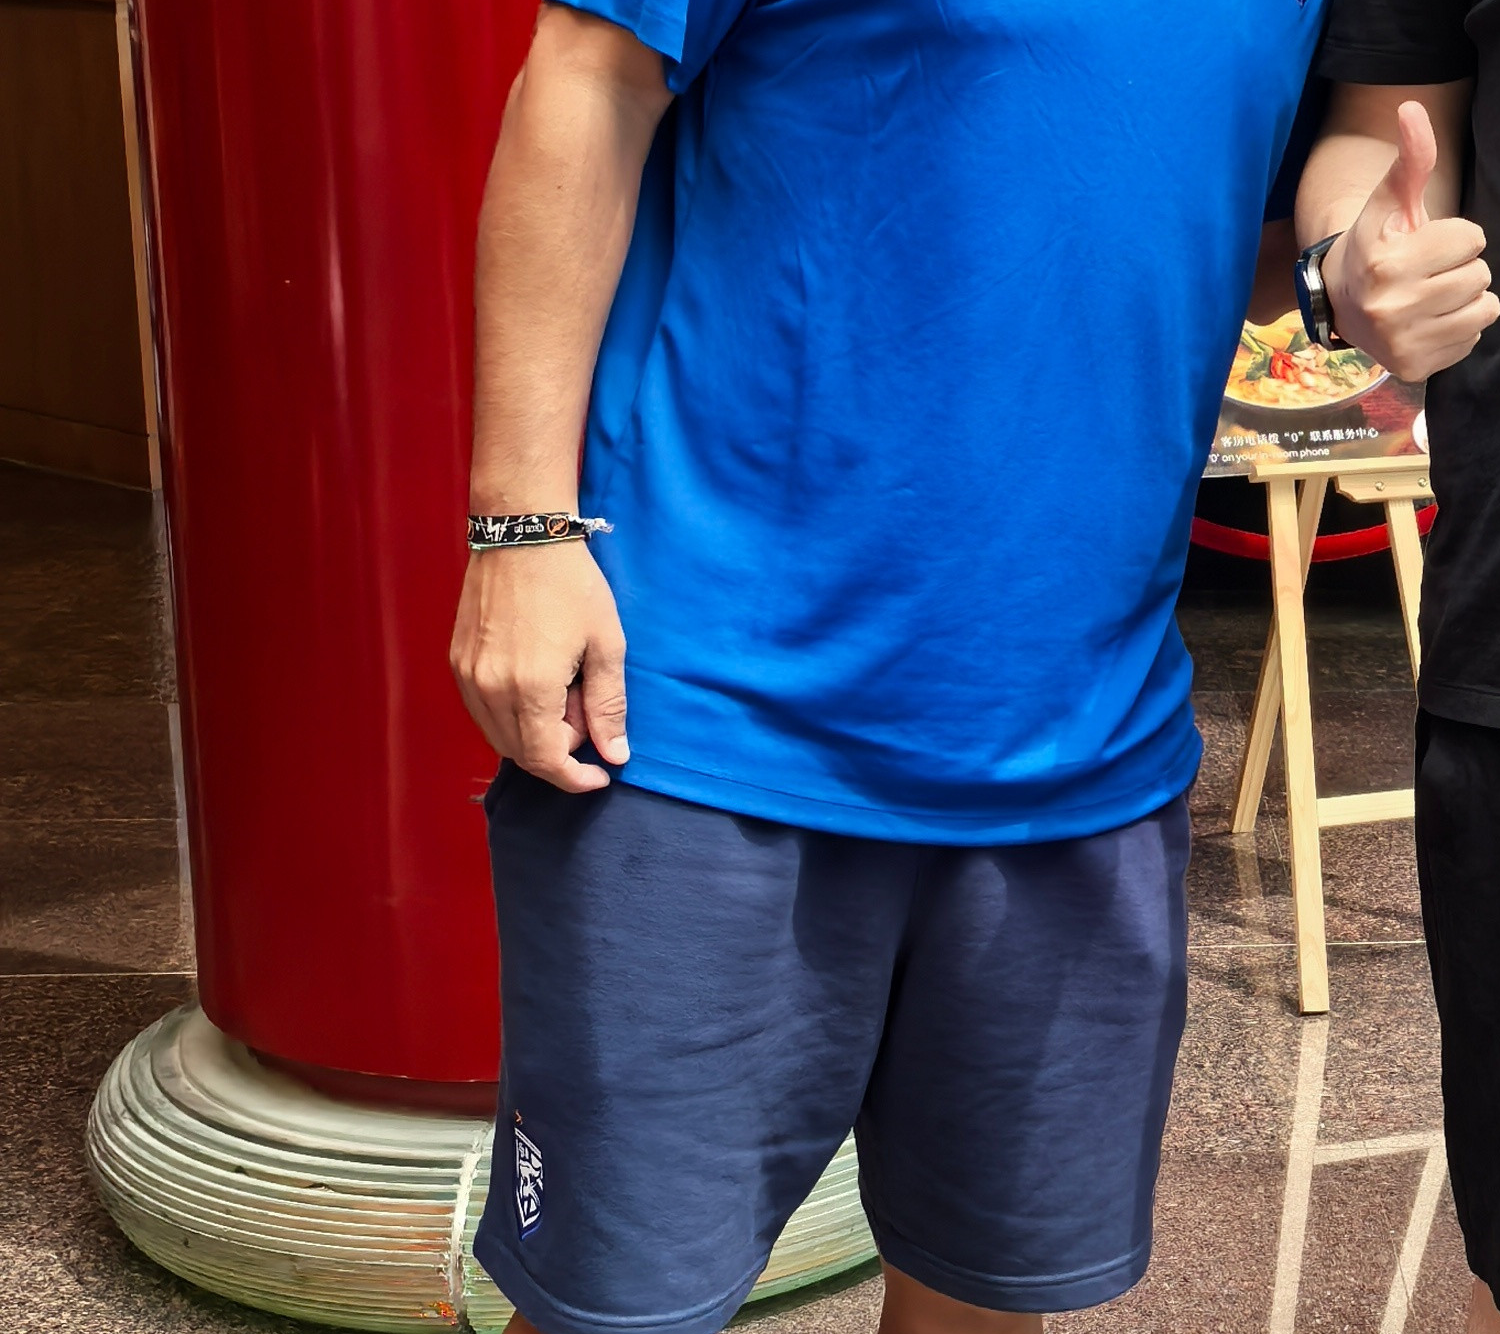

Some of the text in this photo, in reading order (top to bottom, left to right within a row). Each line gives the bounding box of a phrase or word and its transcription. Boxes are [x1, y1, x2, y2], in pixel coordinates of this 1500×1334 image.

[1222, 452, 1235, 462] on
[1236, 451, 1256, 464] your
[1300, 446, 1330, 460] phone
